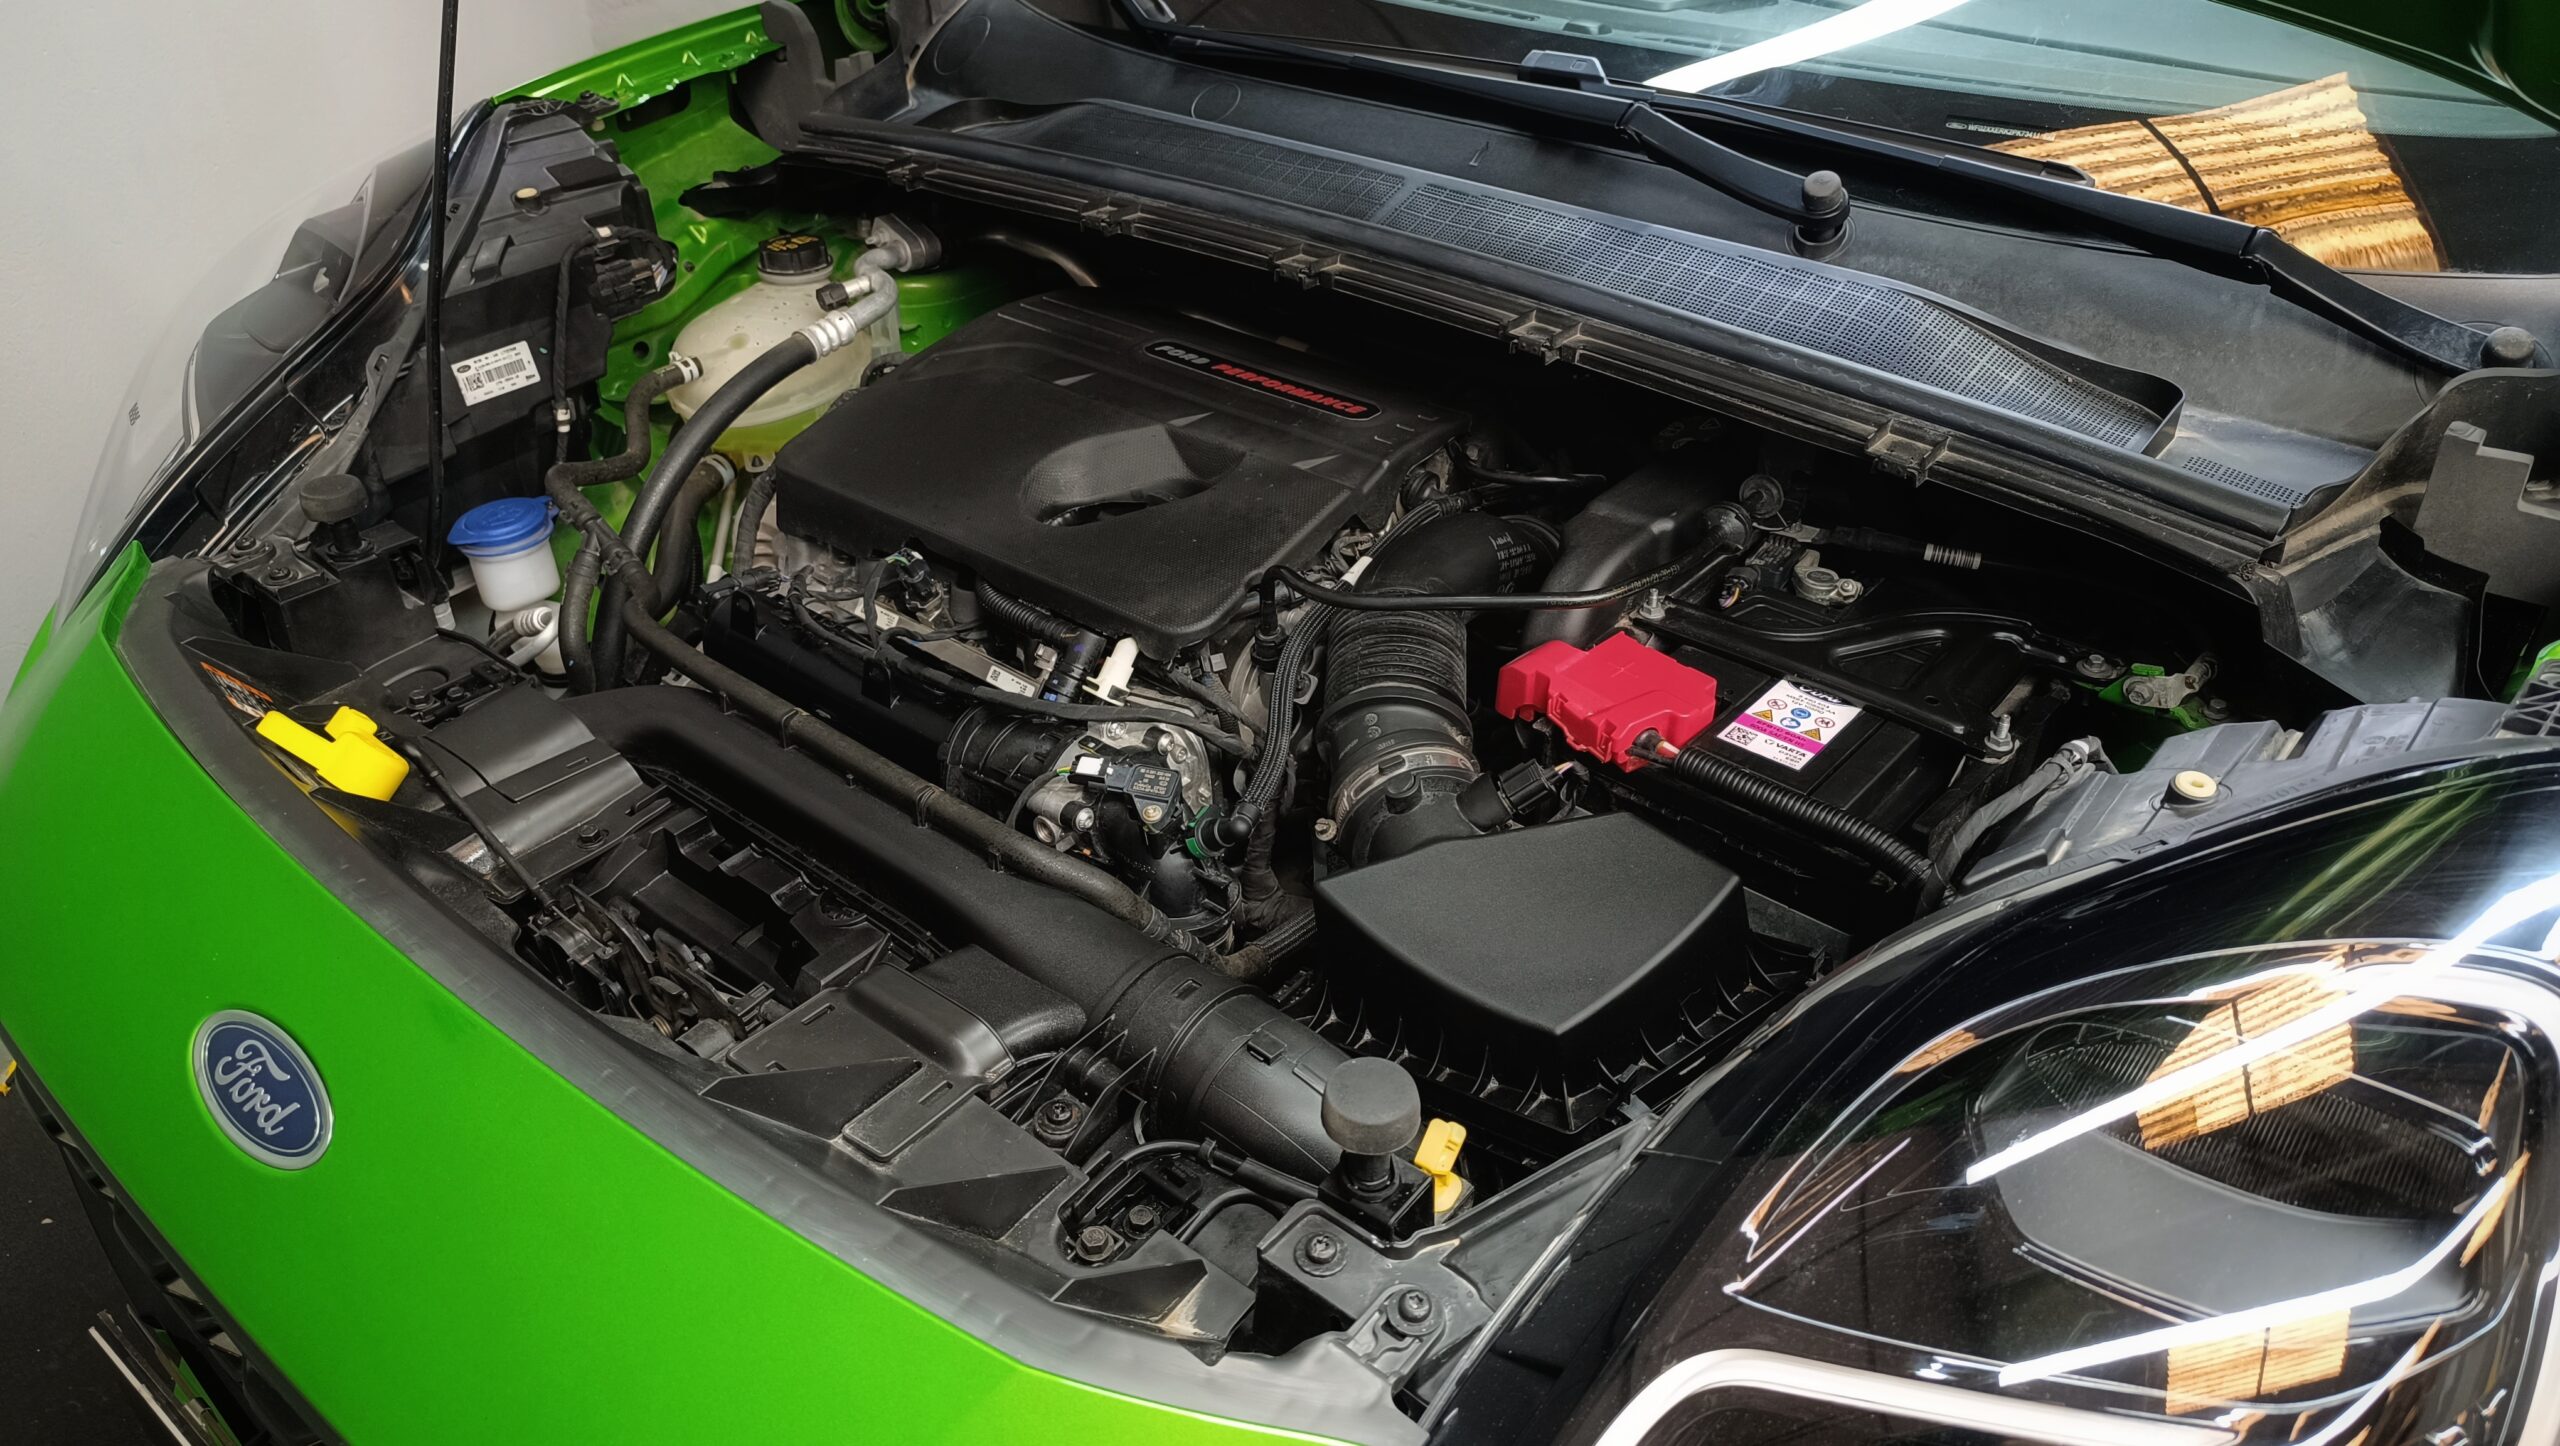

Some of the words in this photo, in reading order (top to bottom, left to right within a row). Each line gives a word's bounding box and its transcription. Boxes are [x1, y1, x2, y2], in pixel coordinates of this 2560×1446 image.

[1154, 345, 1211, 365] FORD
[1210, 363, 1368, 415] PERFORMANCE
[1775, 742, 1808, 758] VARTA
[214, 1039, 301, 1136] Ford
